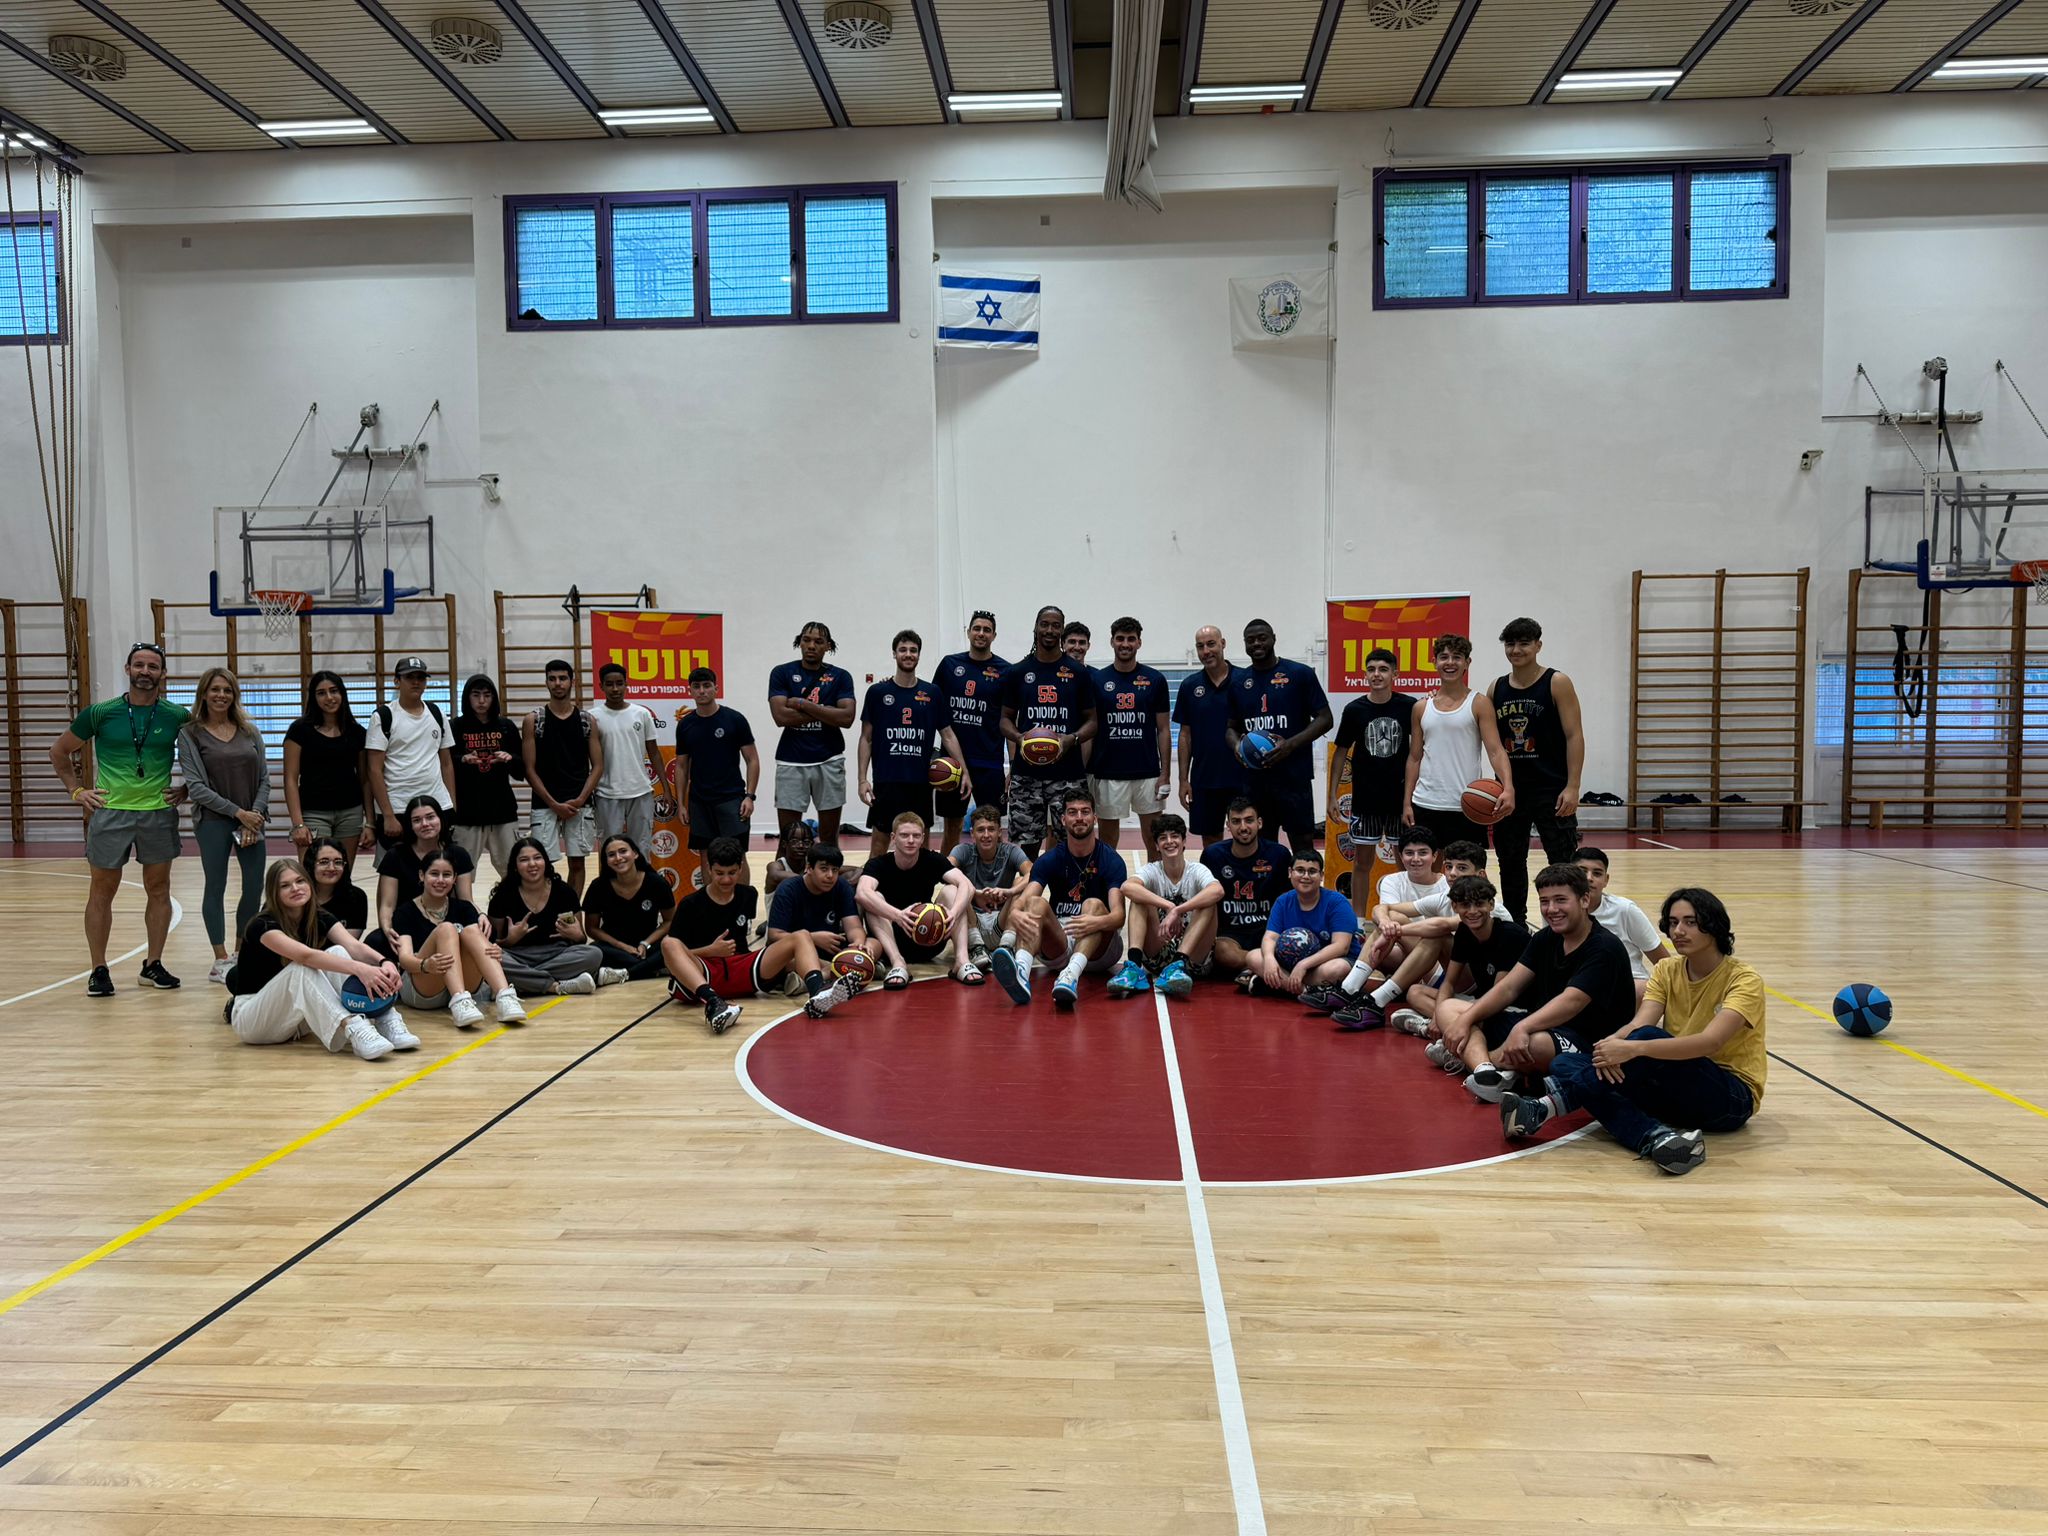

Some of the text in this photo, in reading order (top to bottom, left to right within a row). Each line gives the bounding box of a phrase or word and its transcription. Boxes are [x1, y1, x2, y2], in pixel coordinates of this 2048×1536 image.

[627, 685, 649, 694] בישר
[651, 685, 686, 694] הספורט
[965, 680, 977, 697] 9
[1038, 685, 1058, 703] 55
[950, 696, 987, 712] חי מוטורס
[1116, 693, 1135, 709] 33
[1261, 693, 1268, 713] 1
[902, 707, 912, 725] 2
[1027, 706, 1068, 719] חי מוטורס
[1496, 702, 1545, 719] REALITY
[1107, 711, 1146, 724] חי מוטורס
[1276, 714, 1288, 729] חי
[463, 732, 502, 741] CHICAGO
[886, 728, 925, 741] חי מוטורס
[1109, 726, 1143, 736] Ziona
[468, 740, 497, 748] BULLS
[889, 742, 922, 754] Ziona
[1233, 880, 1254, 900] 14
[1223, 901, 1257, 914] מוטורס
[347, 999, 366, 1008] Voit
